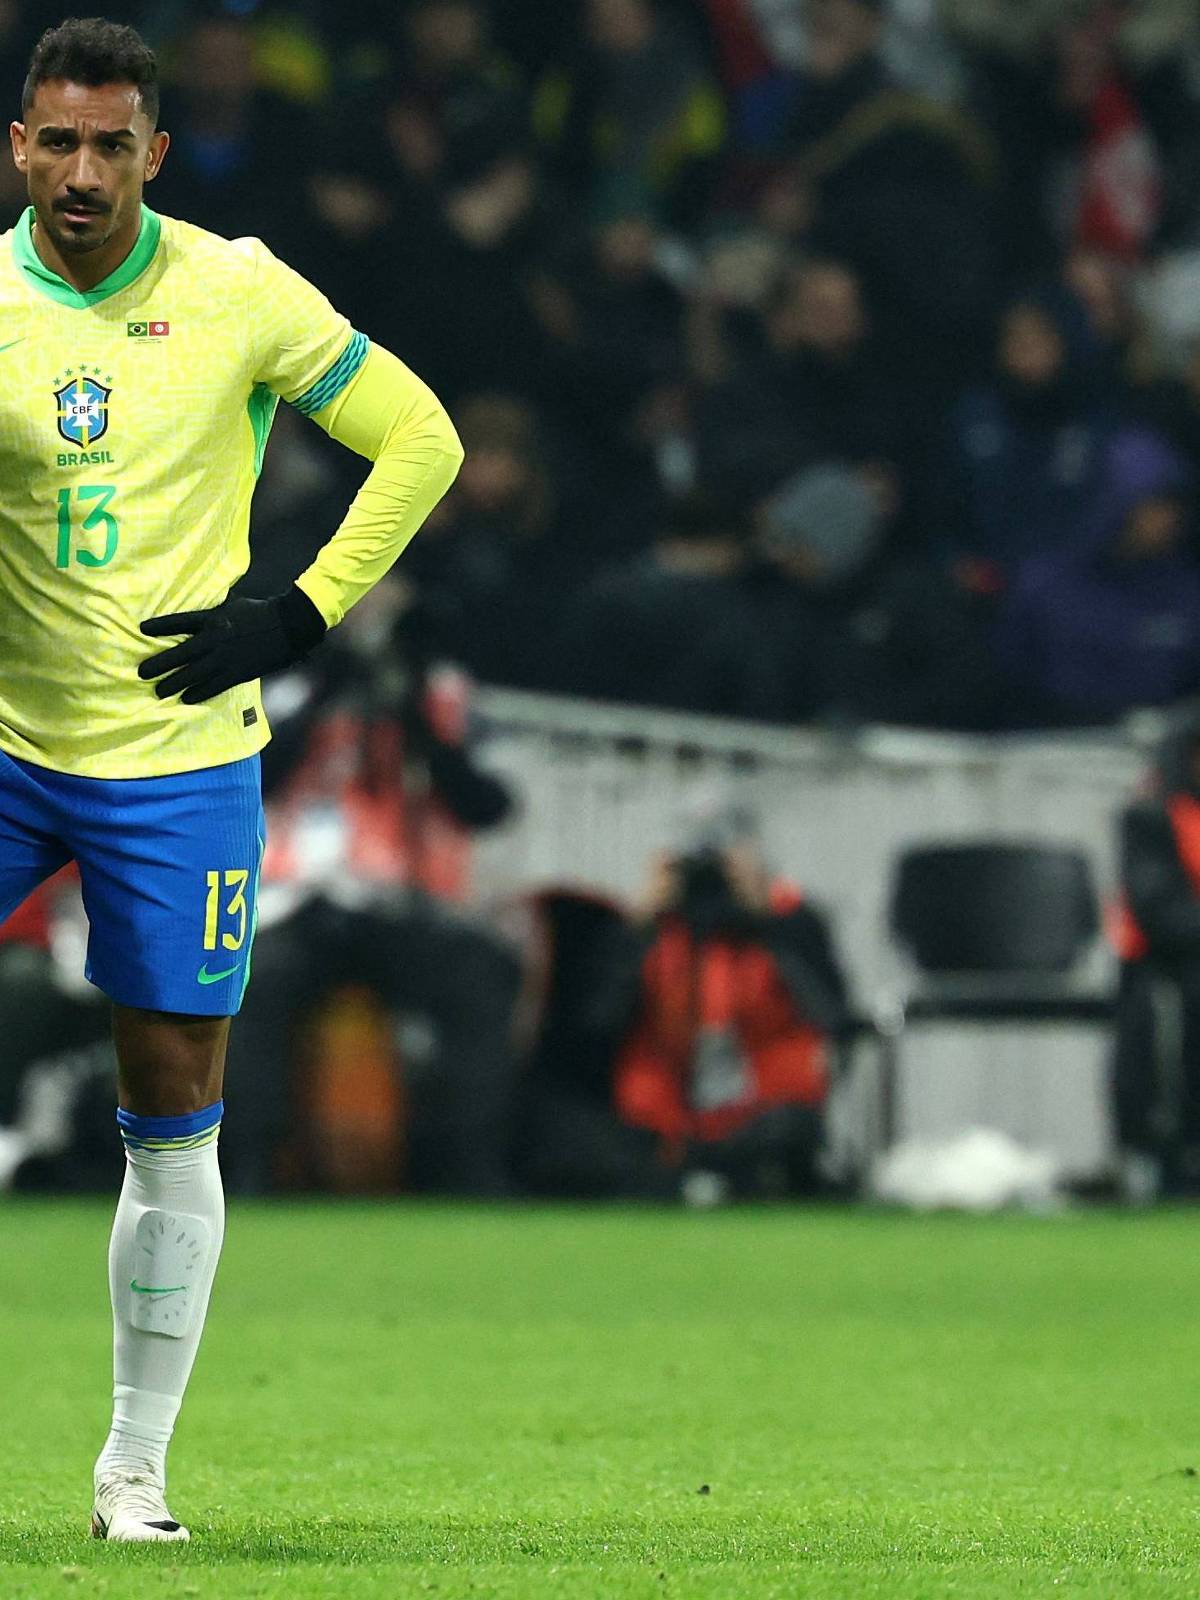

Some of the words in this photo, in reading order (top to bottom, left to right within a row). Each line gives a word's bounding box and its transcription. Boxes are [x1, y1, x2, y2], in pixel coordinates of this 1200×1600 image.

[72, 405, 93, 415] CBF
[57, 451, 114, 467] BRASIL
[56, 485, 119, 569] 13
[203, 869, 249, 951] 13
